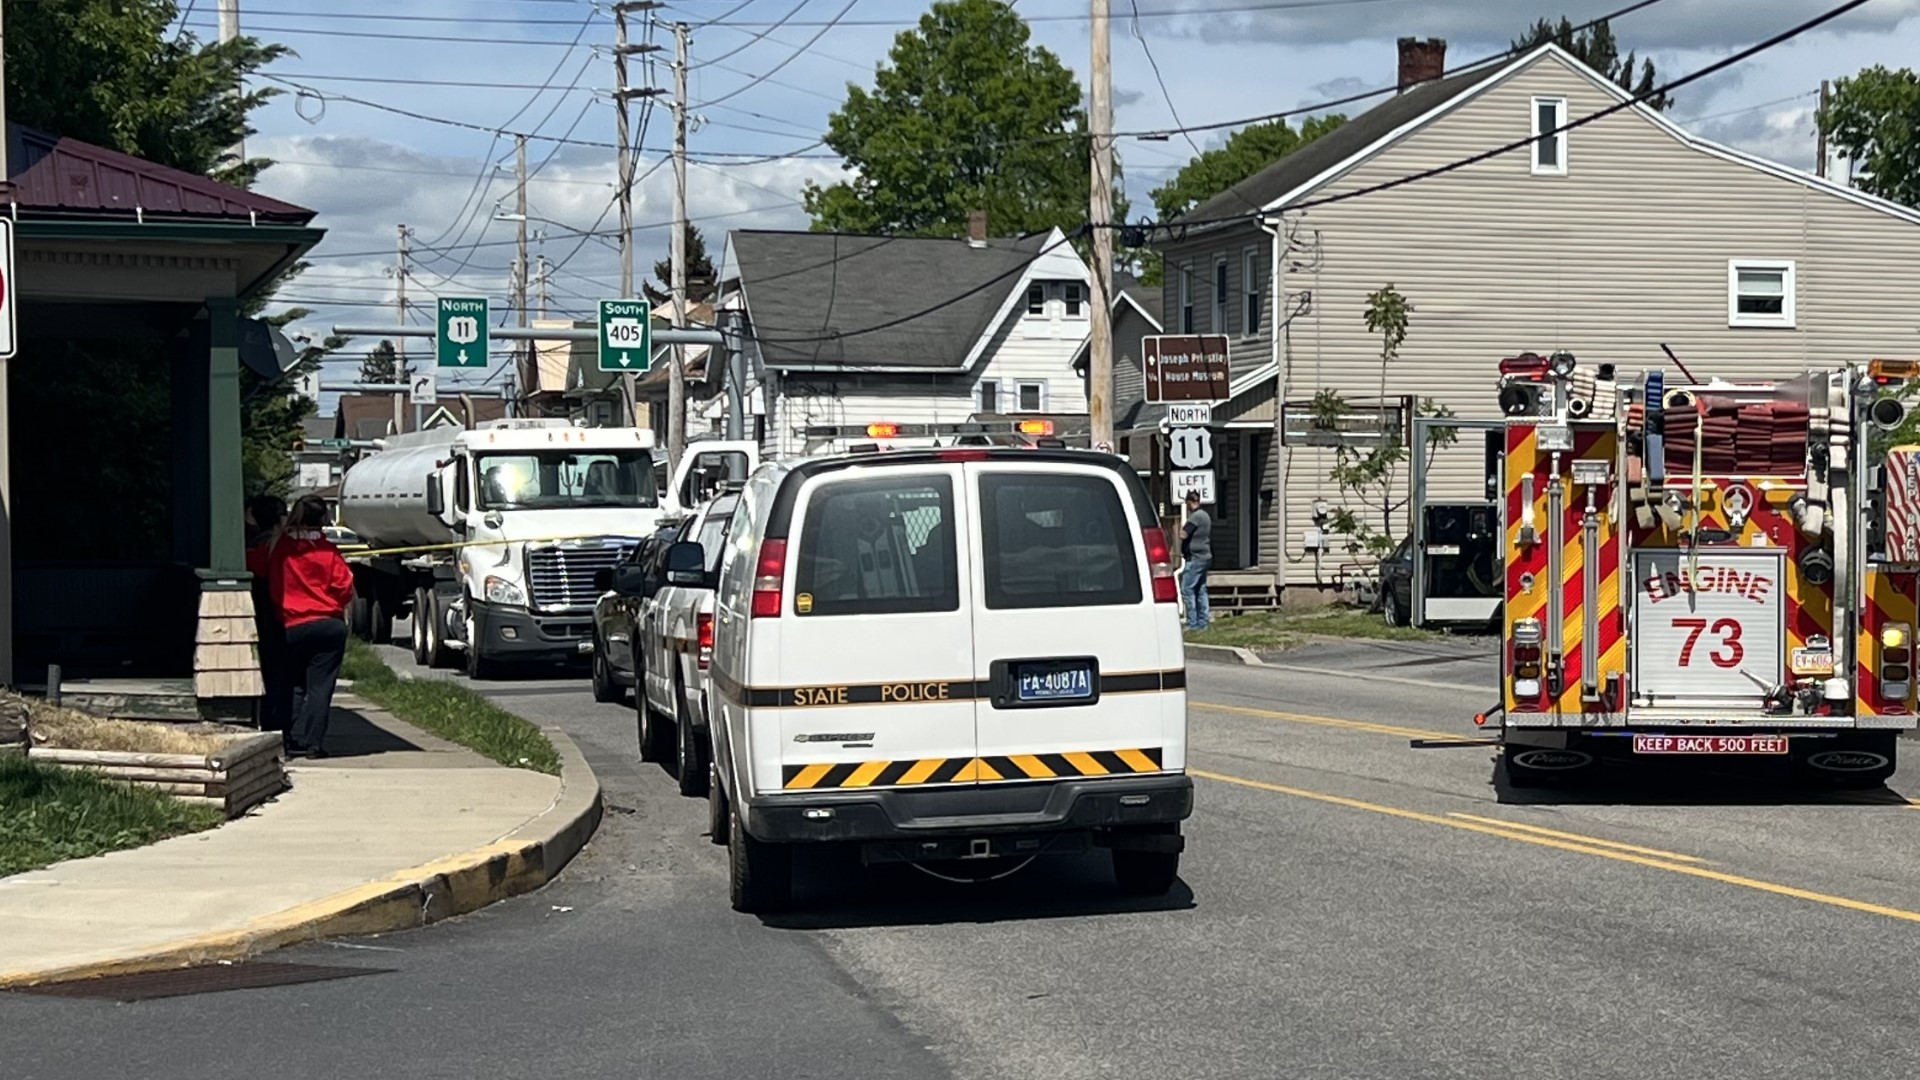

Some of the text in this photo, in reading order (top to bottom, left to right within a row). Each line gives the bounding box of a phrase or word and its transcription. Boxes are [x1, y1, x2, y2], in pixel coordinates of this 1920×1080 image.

[442, 300, 483, 311] NORTH
[605, 303, 644, 315] SOUTH
[457, 321, 469, 337] 11
[610, 325, 639, 341] 405
[1160, 353, 1189, 365] Joseph
[1171, 408, 1208, 421] NORTH
[1178, 436, 1204, 459] 11
[1178, 475, 1206, 486] LEFT
[1643, 566, 1773, 604] ENGINE
[1671, 618, 1744, 668] 73
[1023, 670, 1087, 690] PA-4087A
[794, 683, 949, 706] STATE POLICE
[1637, 738, 1782, 752] KEEP BACK 500 FEET
